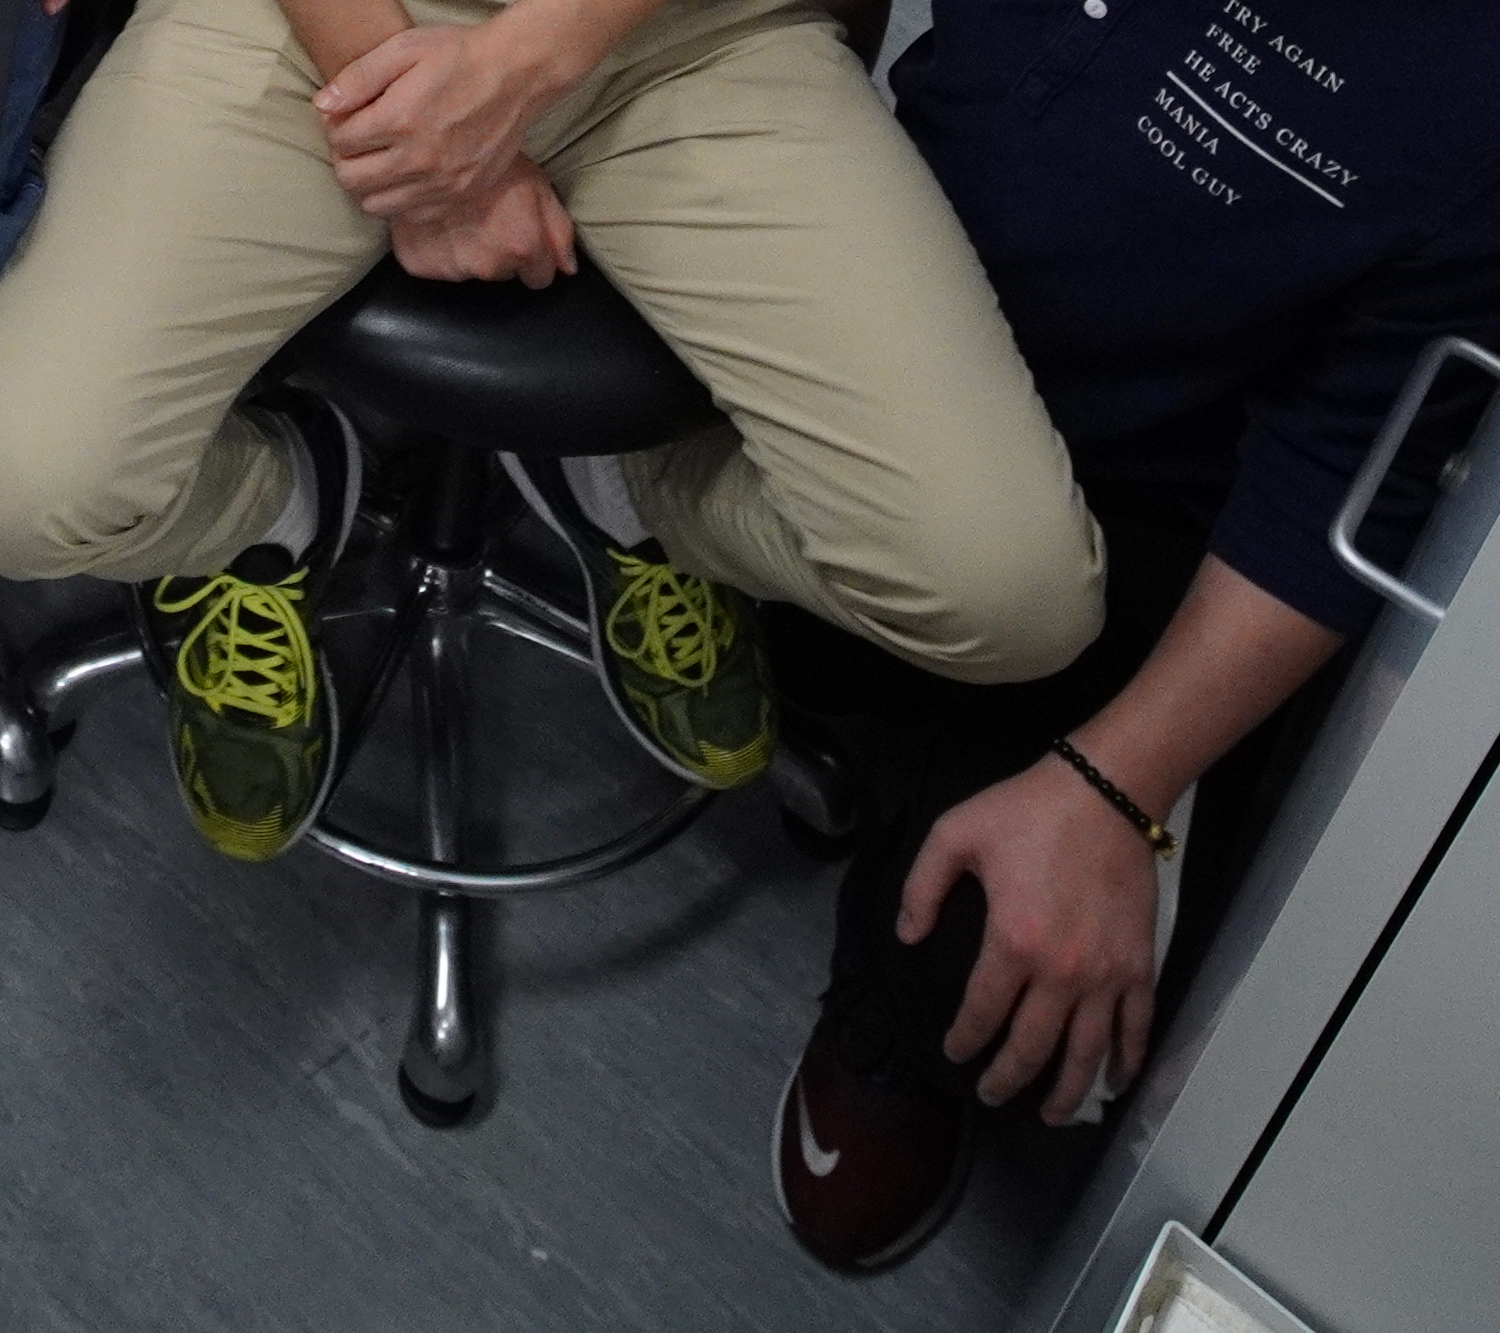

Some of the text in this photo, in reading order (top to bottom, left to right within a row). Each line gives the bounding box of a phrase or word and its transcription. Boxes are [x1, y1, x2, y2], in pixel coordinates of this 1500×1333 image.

[1206, 23, 1262, 75] FREE
[1268, 35, 1345, 94] AGAIN
[1154, 88, 1219, 155] MANIA
[1184, 49, 1360, 187] HE ACTS CRAZY
[1137, 115, 1242, 206] COOL GUY
